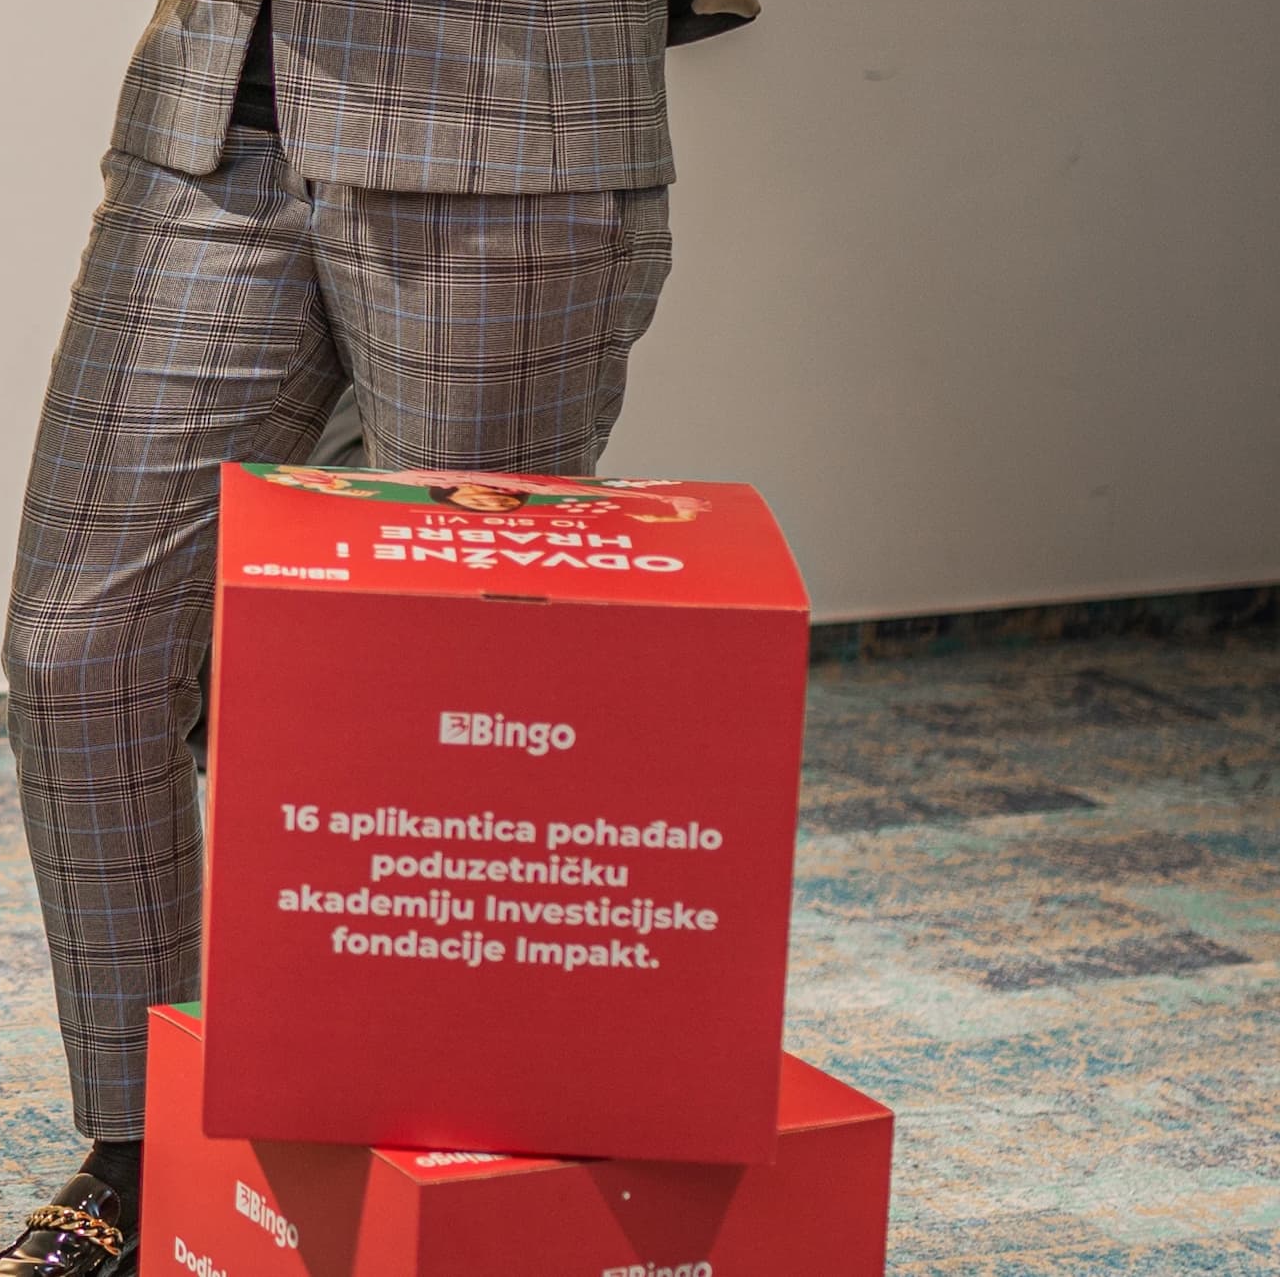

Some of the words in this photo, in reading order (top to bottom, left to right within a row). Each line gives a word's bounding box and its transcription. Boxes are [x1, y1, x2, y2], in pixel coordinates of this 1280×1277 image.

[380, 525, 633, 549] HRABRE
[475, 517, 531, 530] ste
[550, 518, 590, 530] to
[243, 564, 324, 580] Bingo
[374, 543, 684, 573] ODVAŽNE
[470, 712, 576, 756] Bingo
[281, 804, 320, 833] 16
[328, 807, 537, 841] aplikantica
[546, 818, 723, 850] pohađalo
[371, 851, 629, 888] poduzetničku
[277, 884, 475, 926] akademiju
[485, 894, 720, 935] Investicijske
[331, 925, 506, 968] fondacije
[515, 936, 660, 972] Impakt.
[249, 1190, 299, 1249] Bingo
